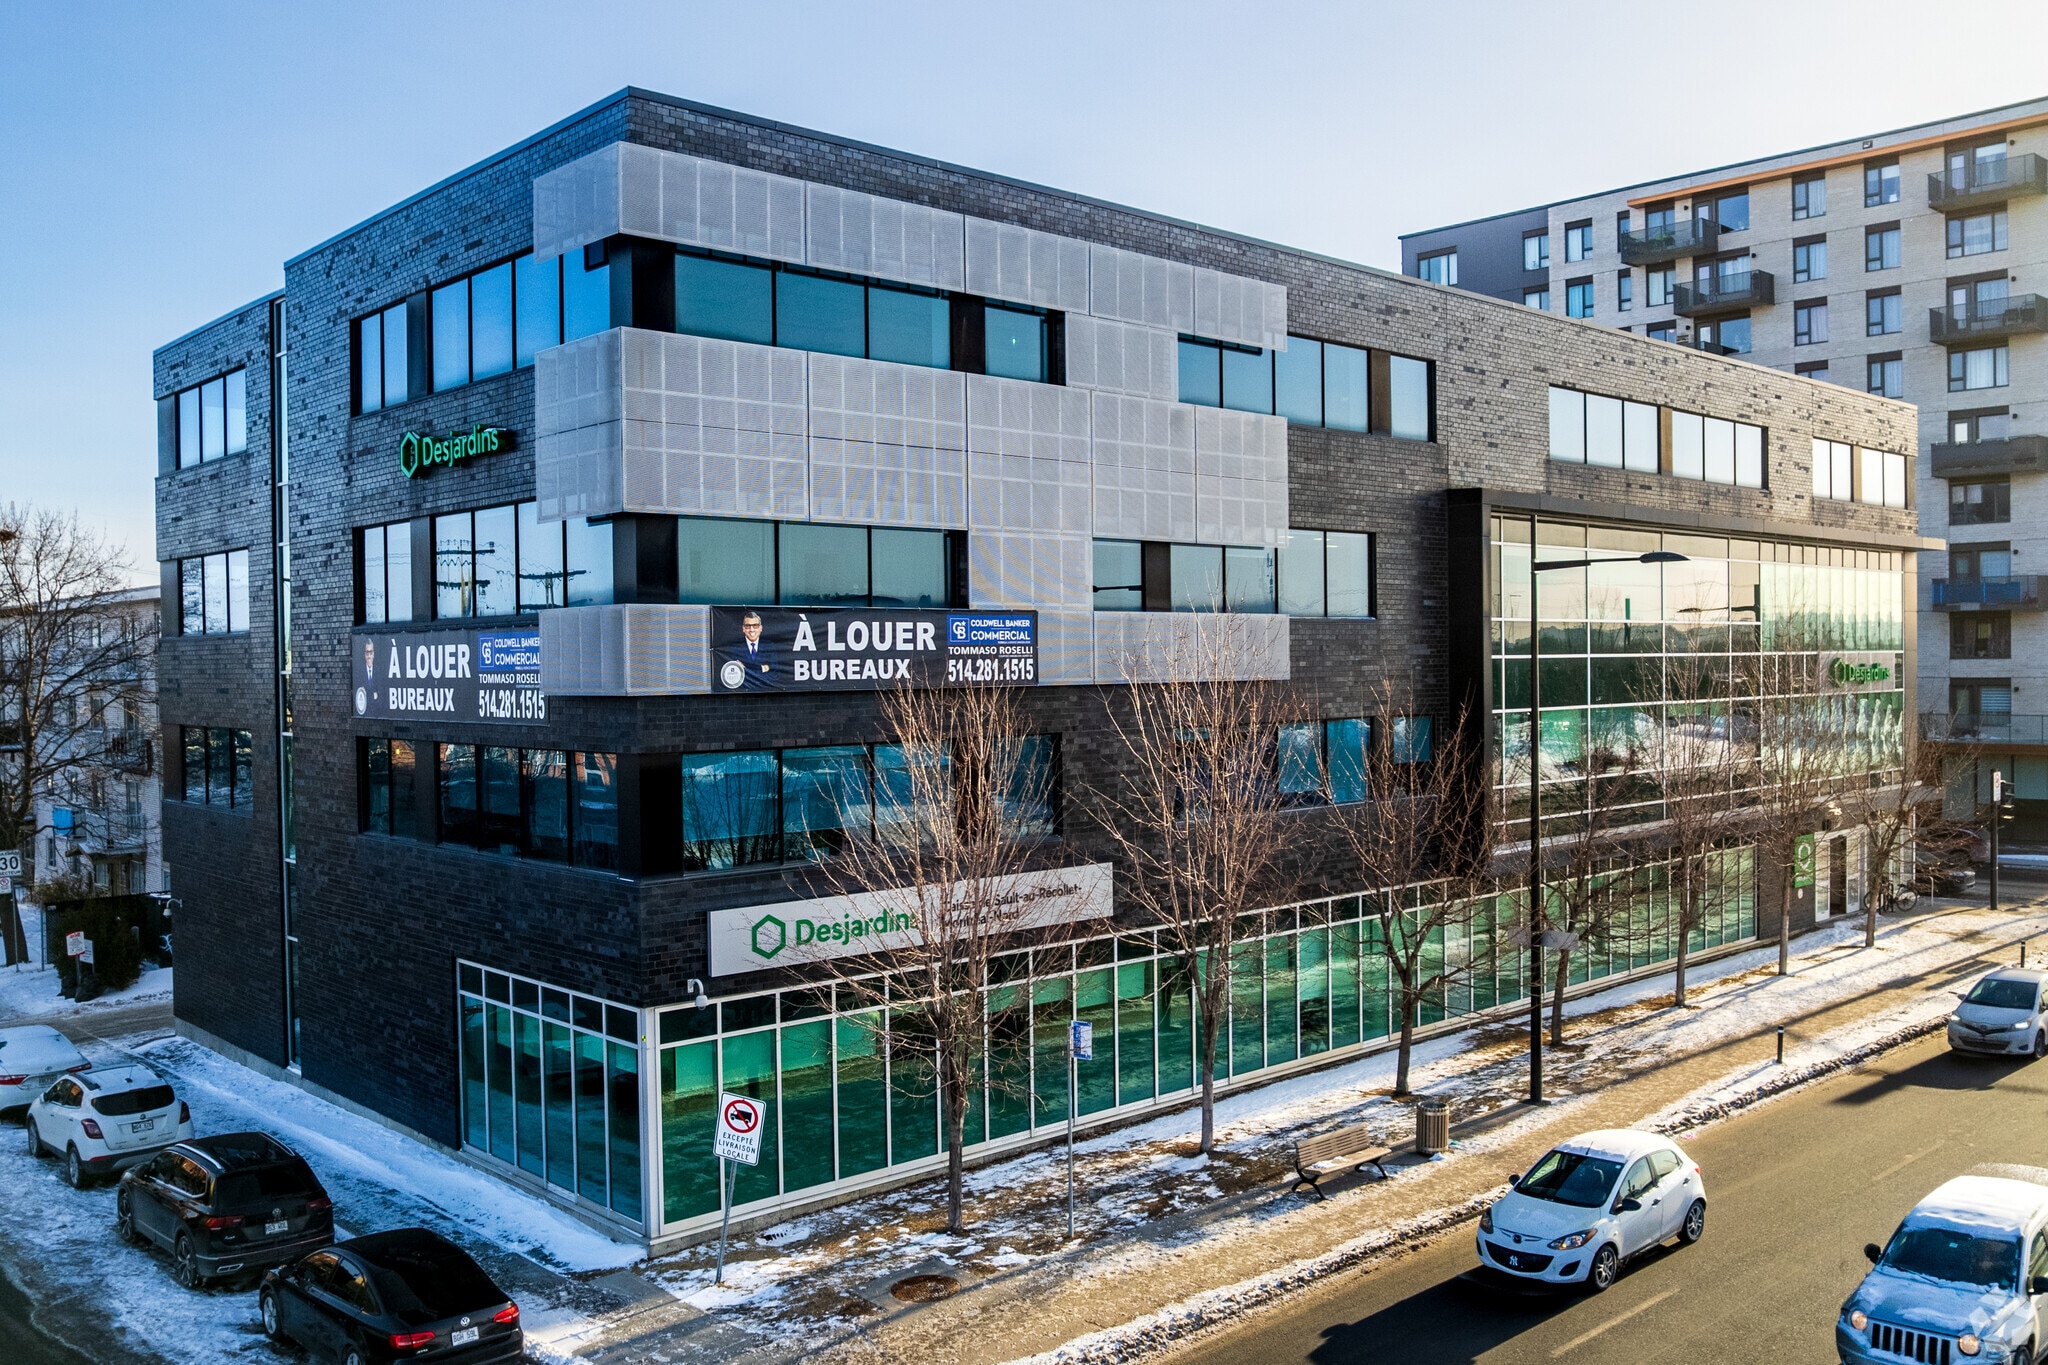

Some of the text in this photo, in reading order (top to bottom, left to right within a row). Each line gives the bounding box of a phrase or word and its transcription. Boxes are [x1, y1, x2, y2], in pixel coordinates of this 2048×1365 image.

[422, 423, 499, 467] Desjardins
[970, 619, 1031, 627] COLDWELL BANKER
[793, 614, 937, 651] À LOUER
[971, 630, 1031, 641] COMMERCIAL
[494, 638, 521, 648] COLDWELL
[948, 646, 1033, 655] TOMMASO ROSELLI
[388, 638, 471, 679] À LOUER
[794, 658, 911, 682] BUREAUX
[948, 658, 1034, 682] 514.281.1515
[1849, 663, 1890, 684] Desjardins
[478, 674, 515, 684] TOMMASO
[389, 687, 455, 712] BUREAUX
[478, 689, 545, 719] 514.281.1515
[0, 856, 19, 870] 30
[723, 1131, 753, 1145] EXCEPTÉ
[718, 1139, 756, 1154] LIVRAISON
[722, 1148, 749, 1160] LOCALE
